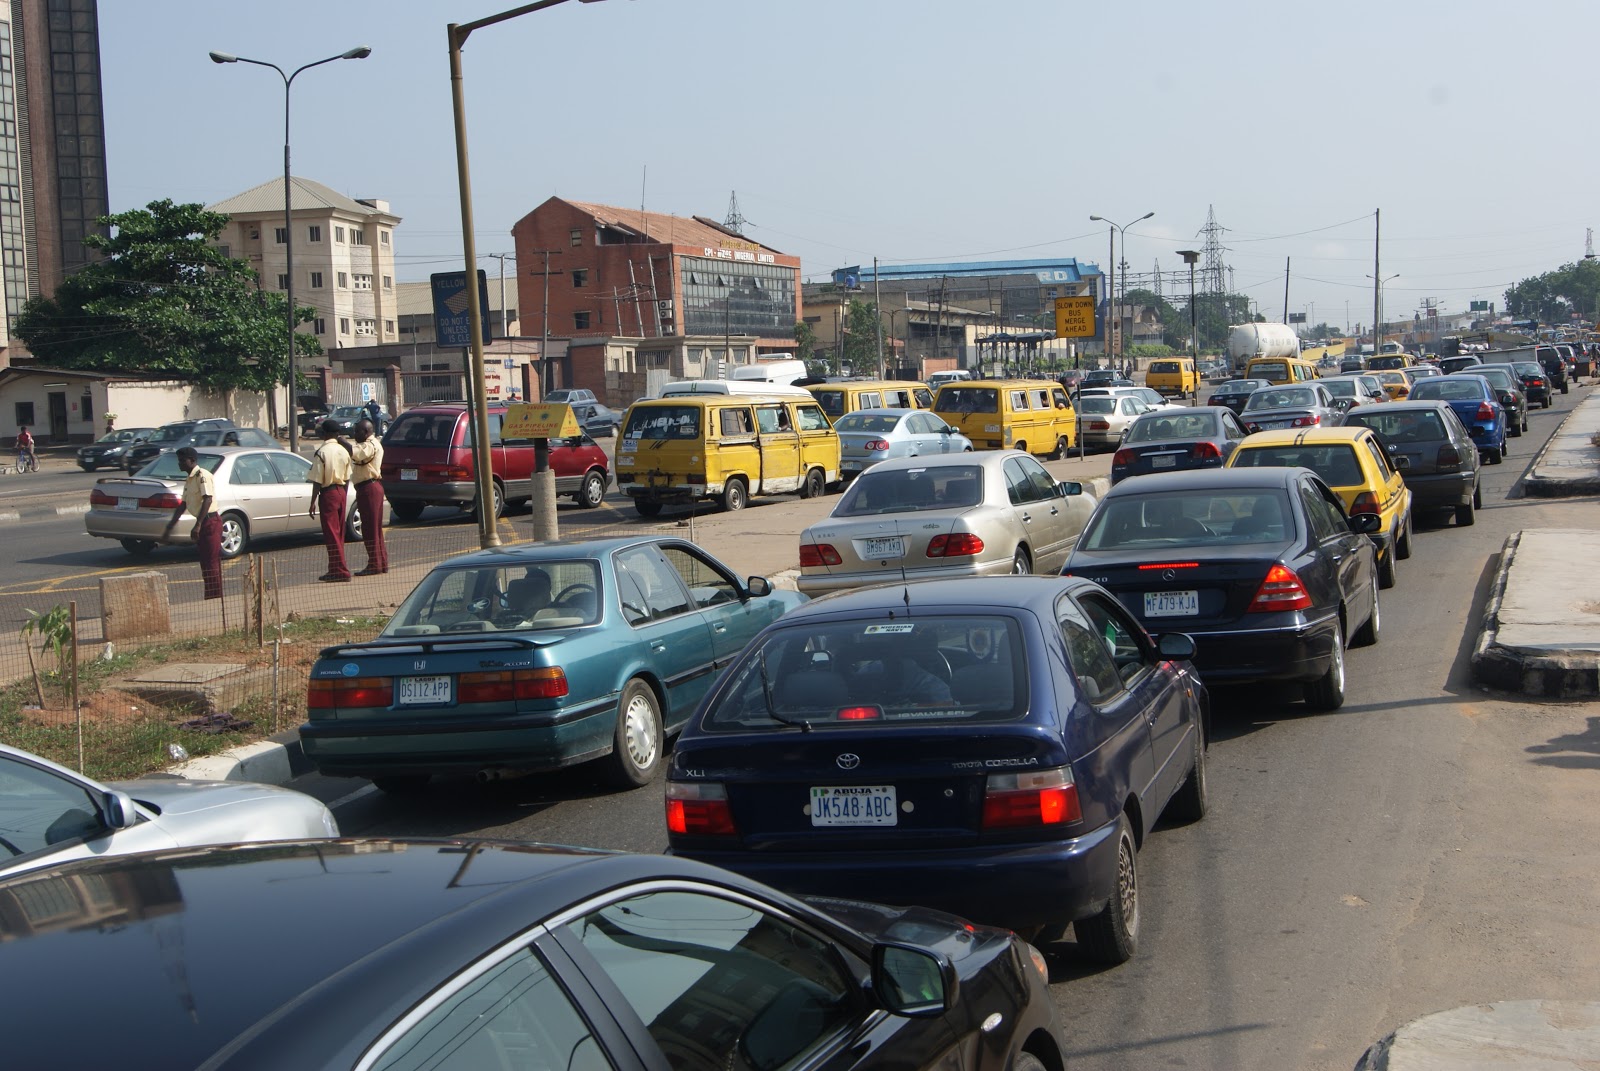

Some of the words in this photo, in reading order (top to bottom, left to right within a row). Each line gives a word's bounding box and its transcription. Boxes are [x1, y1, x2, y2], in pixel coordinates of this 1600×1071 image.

[758, 254, 775, 263] LIMITED
[436, 279, 465, 289] YELLOW
[440, 318, 449, 326] DO
[451, 317, 463, 325] NOT
[443, 326, 468, 335] UNLESS
[449, 335, 455, 343] IS
[457, 334, 471, 342] CLE
[952, 761, 983, 769] TOYOTA
[985, 757, 1039, 767] COROLLA
